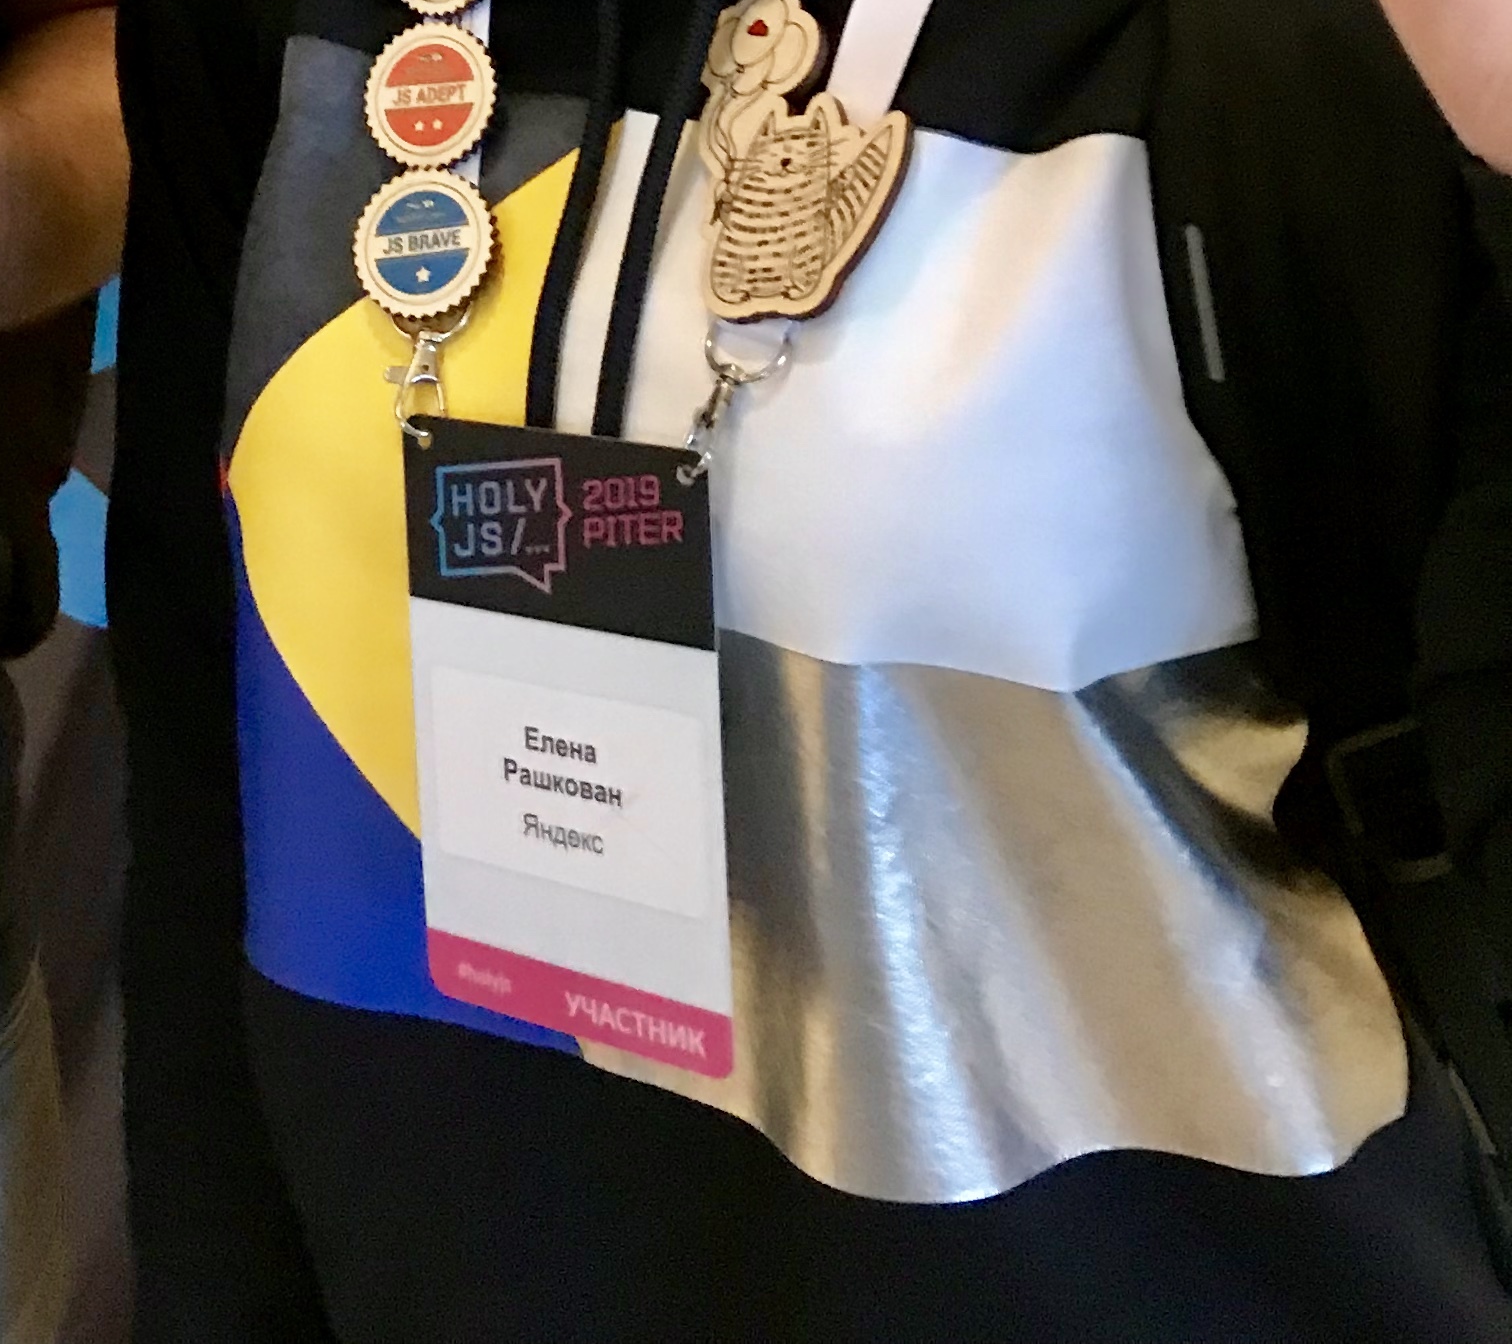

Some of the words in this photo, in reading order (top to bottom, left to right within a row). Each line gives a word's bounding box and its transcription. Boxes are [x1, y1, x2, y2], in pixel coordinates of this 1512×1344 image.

[392, 87, 412, 107] JS
[415, 83, 467, 105] ADEPT
[383, 236, 404, 255] JS
[407, 228, 461, 252] BRAVE
[451, 477, 548, 517] HOLY
[581, 474, 660, 511] 2019
[582, 509, 685, 549] PITER
[524, 725, 597, 764] Елена
[503, 757, 623, 808] Рашкован
[523, 812, 605, 855] Яндекс
[564, 990, 707, 1060] УЧАСТНИК
